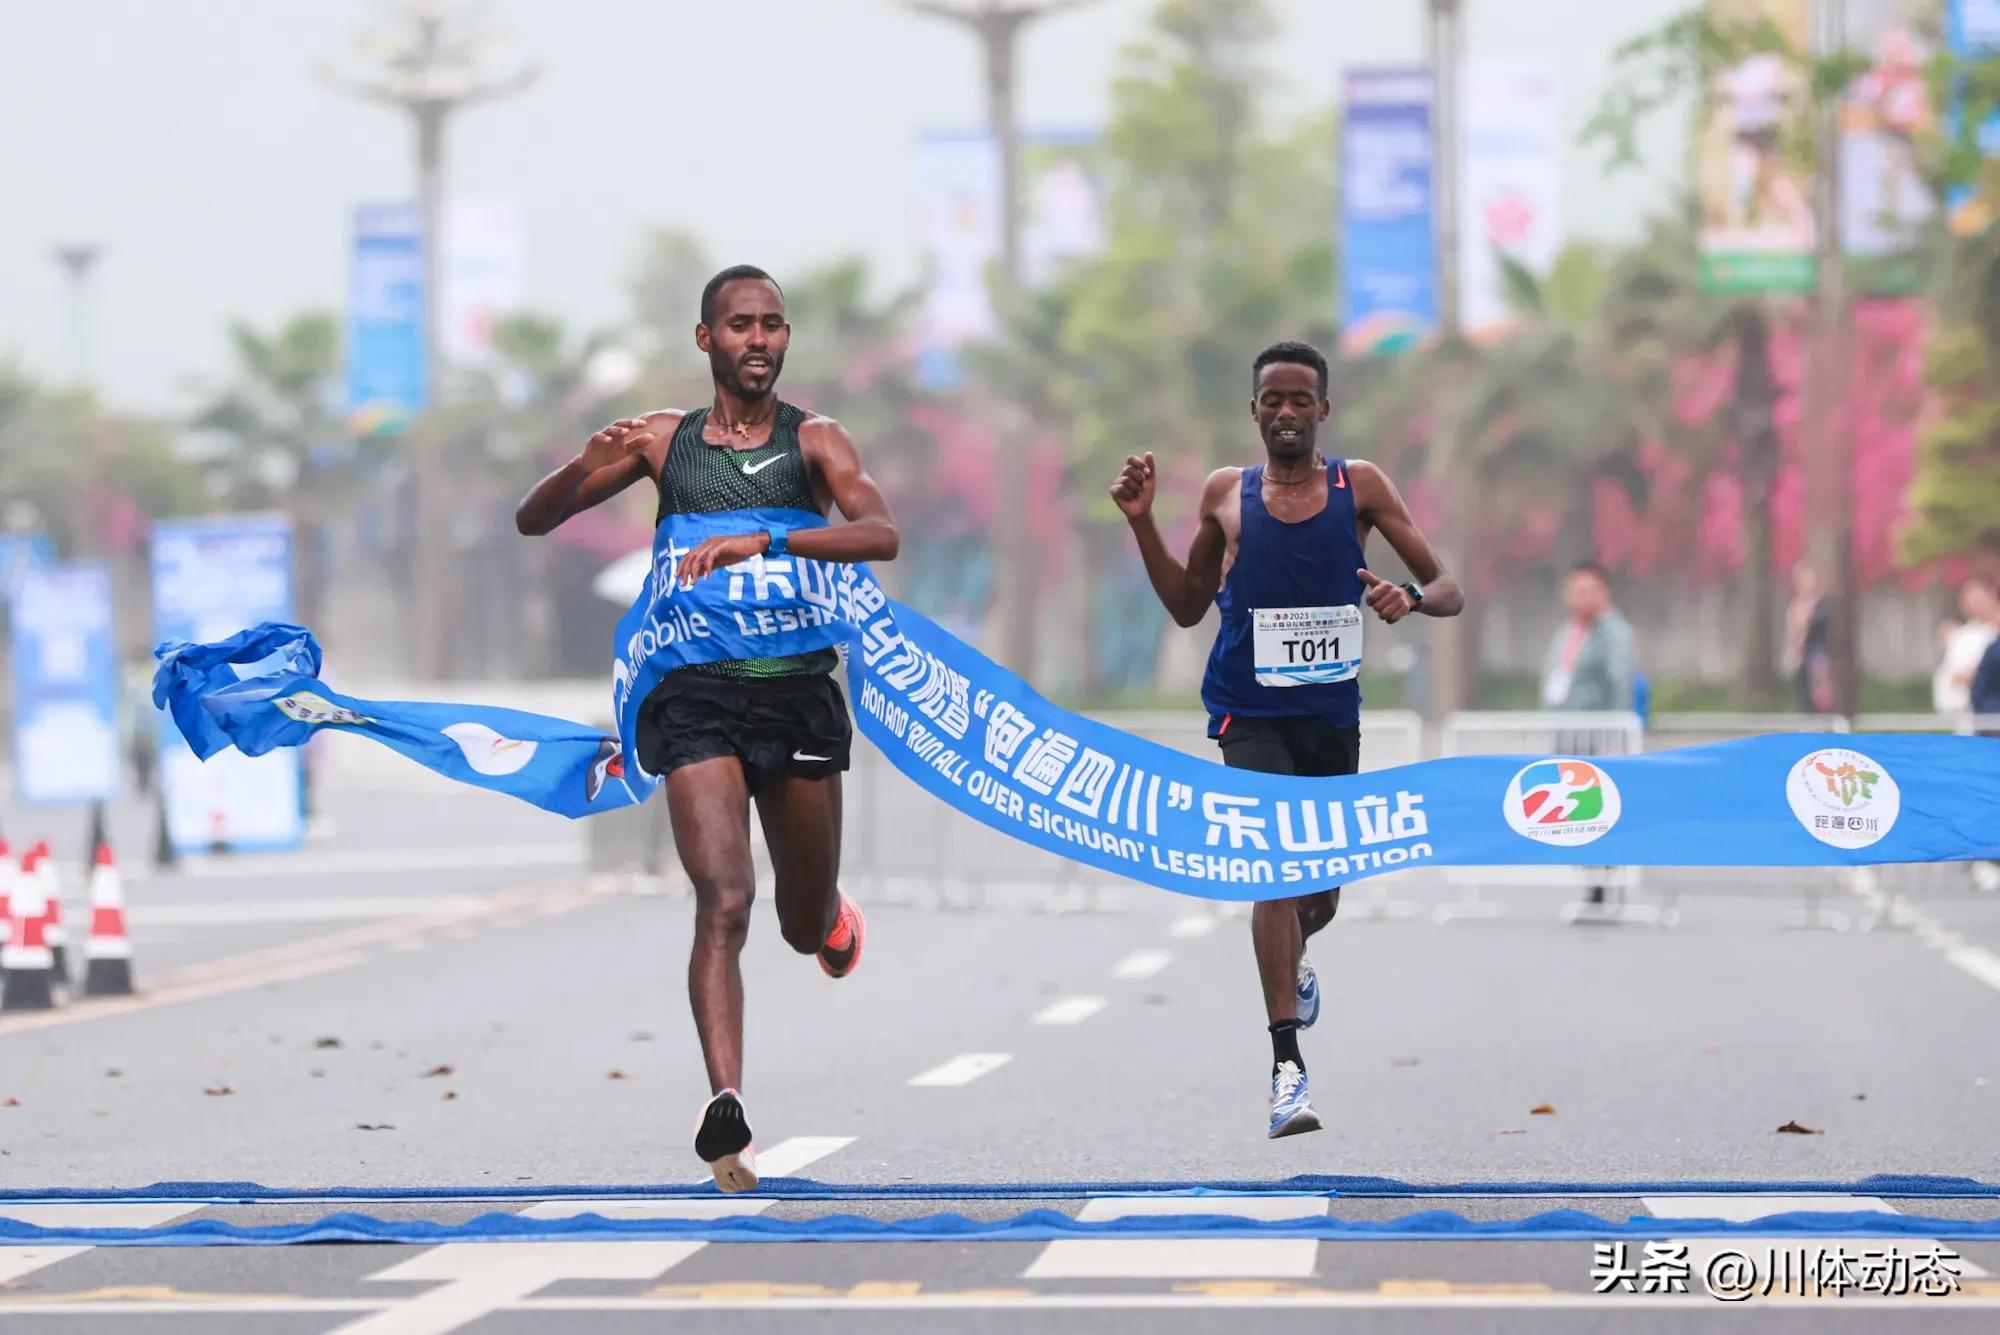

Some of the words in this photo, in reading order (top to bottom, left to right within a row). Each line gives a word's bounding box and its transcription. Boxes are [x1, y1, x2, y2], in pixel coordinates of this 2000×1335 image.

[1290, 612, 1309, 620] 2023
[1282, 637, 1340, 664] T011
[733, 606, 840, 637] LESHA
[930, 749, 970, 786] ALL
[967, 770, 1024, 822] OVER
[1150, 845, 1275, 884] LESHAN
[1280, 842, 1433, 883] STATION
